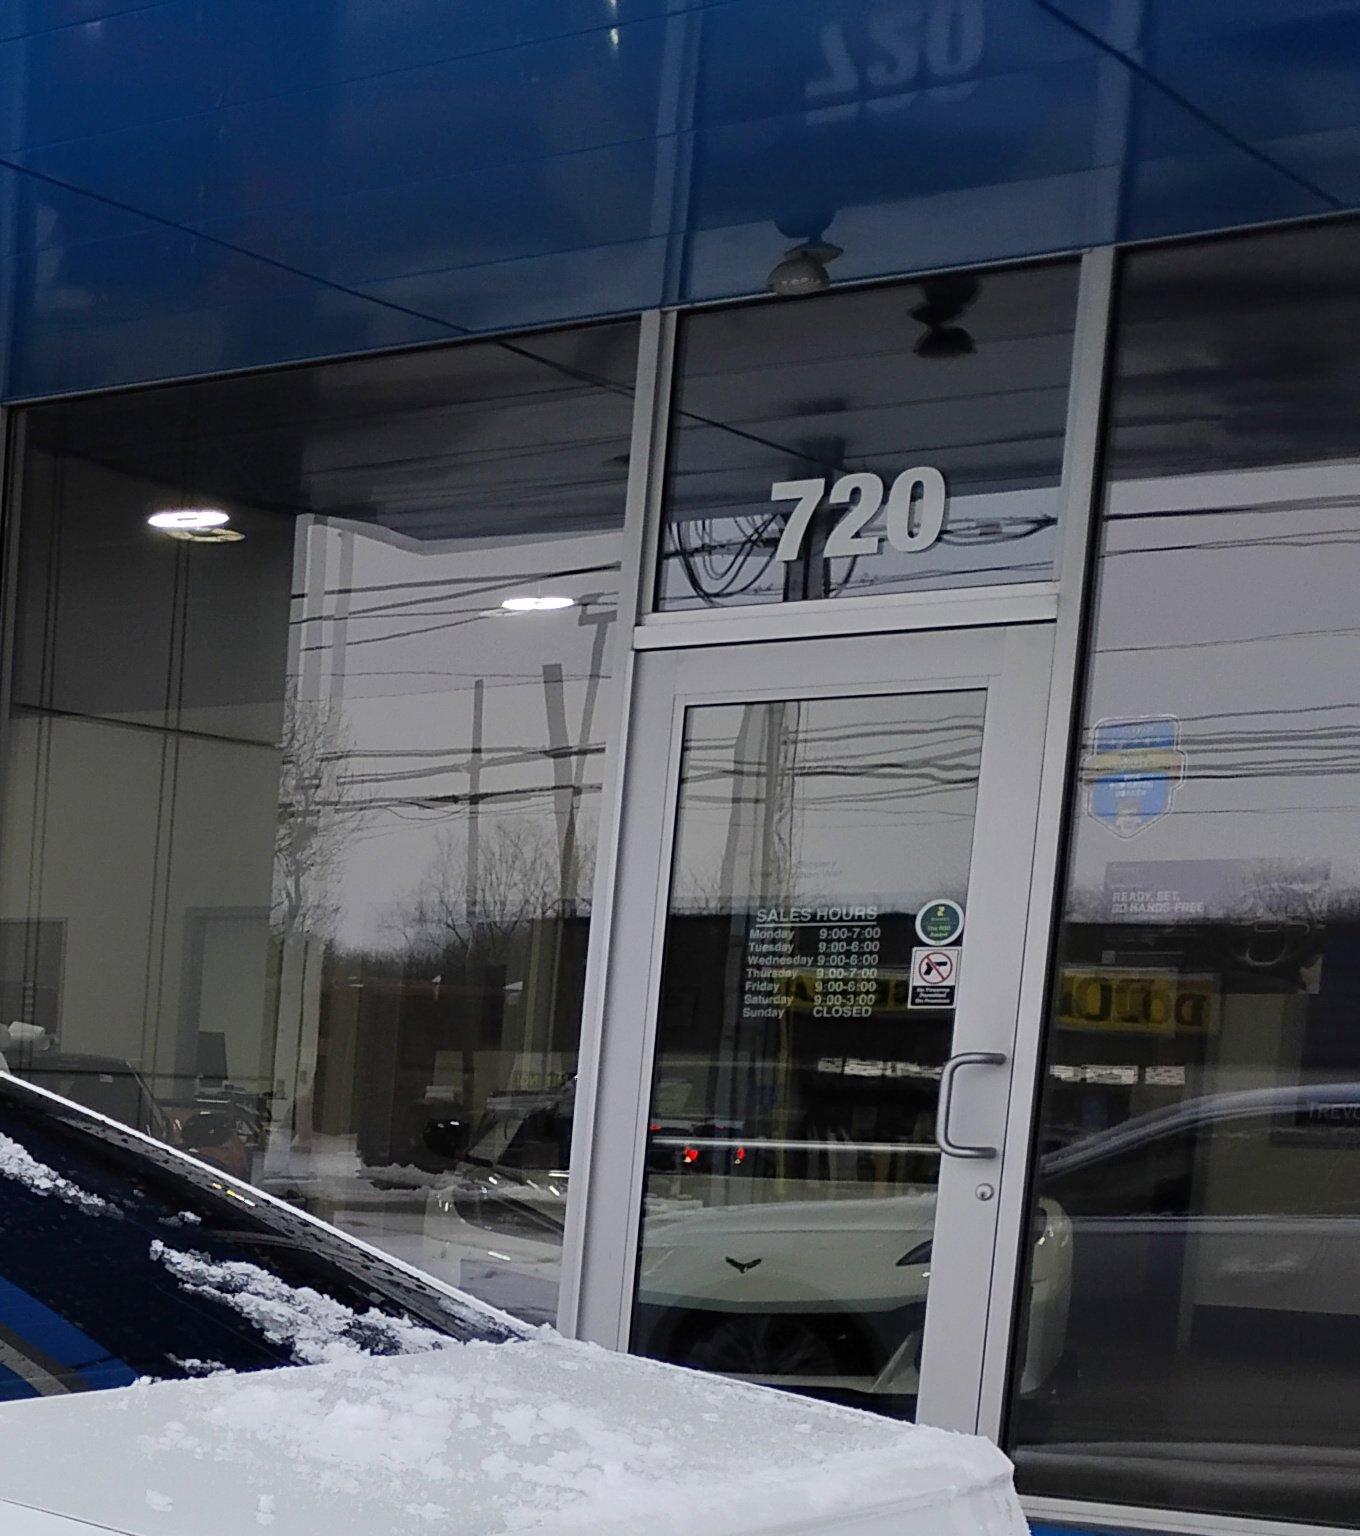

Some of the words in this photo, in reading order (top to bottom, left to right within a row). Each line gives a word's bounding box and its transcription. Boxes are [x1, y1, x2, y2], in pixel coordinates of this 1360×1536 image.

[771, 466, 946, 561] 720
[756, 908, 812, 923] SALES
[817, 906, 878, 921] HOURS
[749, 928, 795, 940] Monday
[819, 928, 881, 939] 9:00-7:00
[748, 942, 794, 953] Tuesday
[818, 941, 880, 952] 9:00-6:00
[747, 955, 814, 967] Wednesday
[817, 954, 879, 966] 9:00-6:00
[746, 968, 798, 980] Thursday
[816, 967, 878, 979] 9:00-7:00
[745, 981, 780, 993] Friday
[815, 981, 877, 992] 9:00-6:00
[744, 994, 794, 1006] Saturday
[813, 994, 875, 1005] 9:00-3:00
[742, 1007, 785, 1019] Sunday
[813, 1006, 872, 1018] CLOSED
